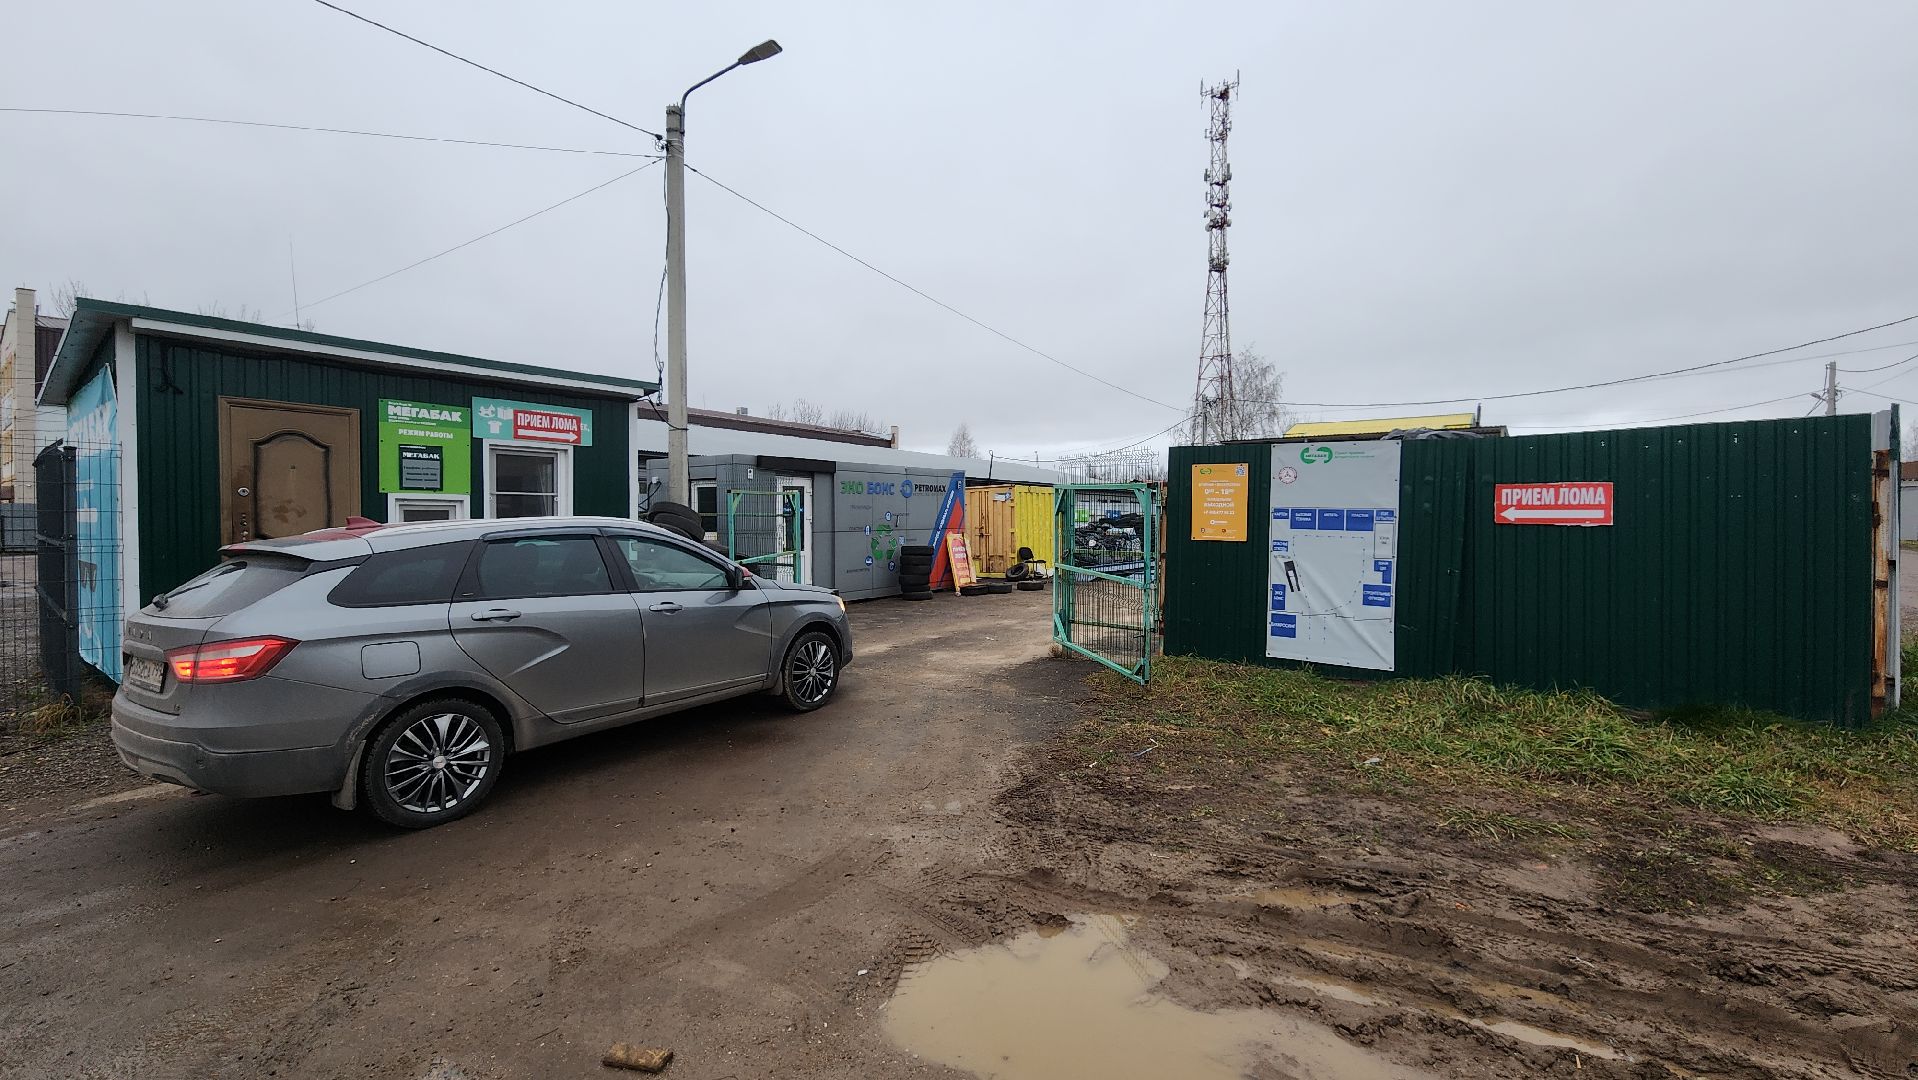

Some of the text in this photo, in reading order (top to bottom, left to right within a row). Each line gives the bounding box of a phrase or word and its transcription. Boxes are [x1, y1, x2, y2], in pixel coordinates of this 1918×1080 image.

[387, 404, 463, 423] МЕГАБАК
[517, 412, 551, 429] ПРИЕМ
[551, 416, 578, 432] ЛОМА
[398, 428, 454, 439] РЕЖИМ РАБОТЫ
[402, 451, 440, 460] МЕГАБАК
[1501, 486, 1606, 506] ПРИЕМ ЛОМА
